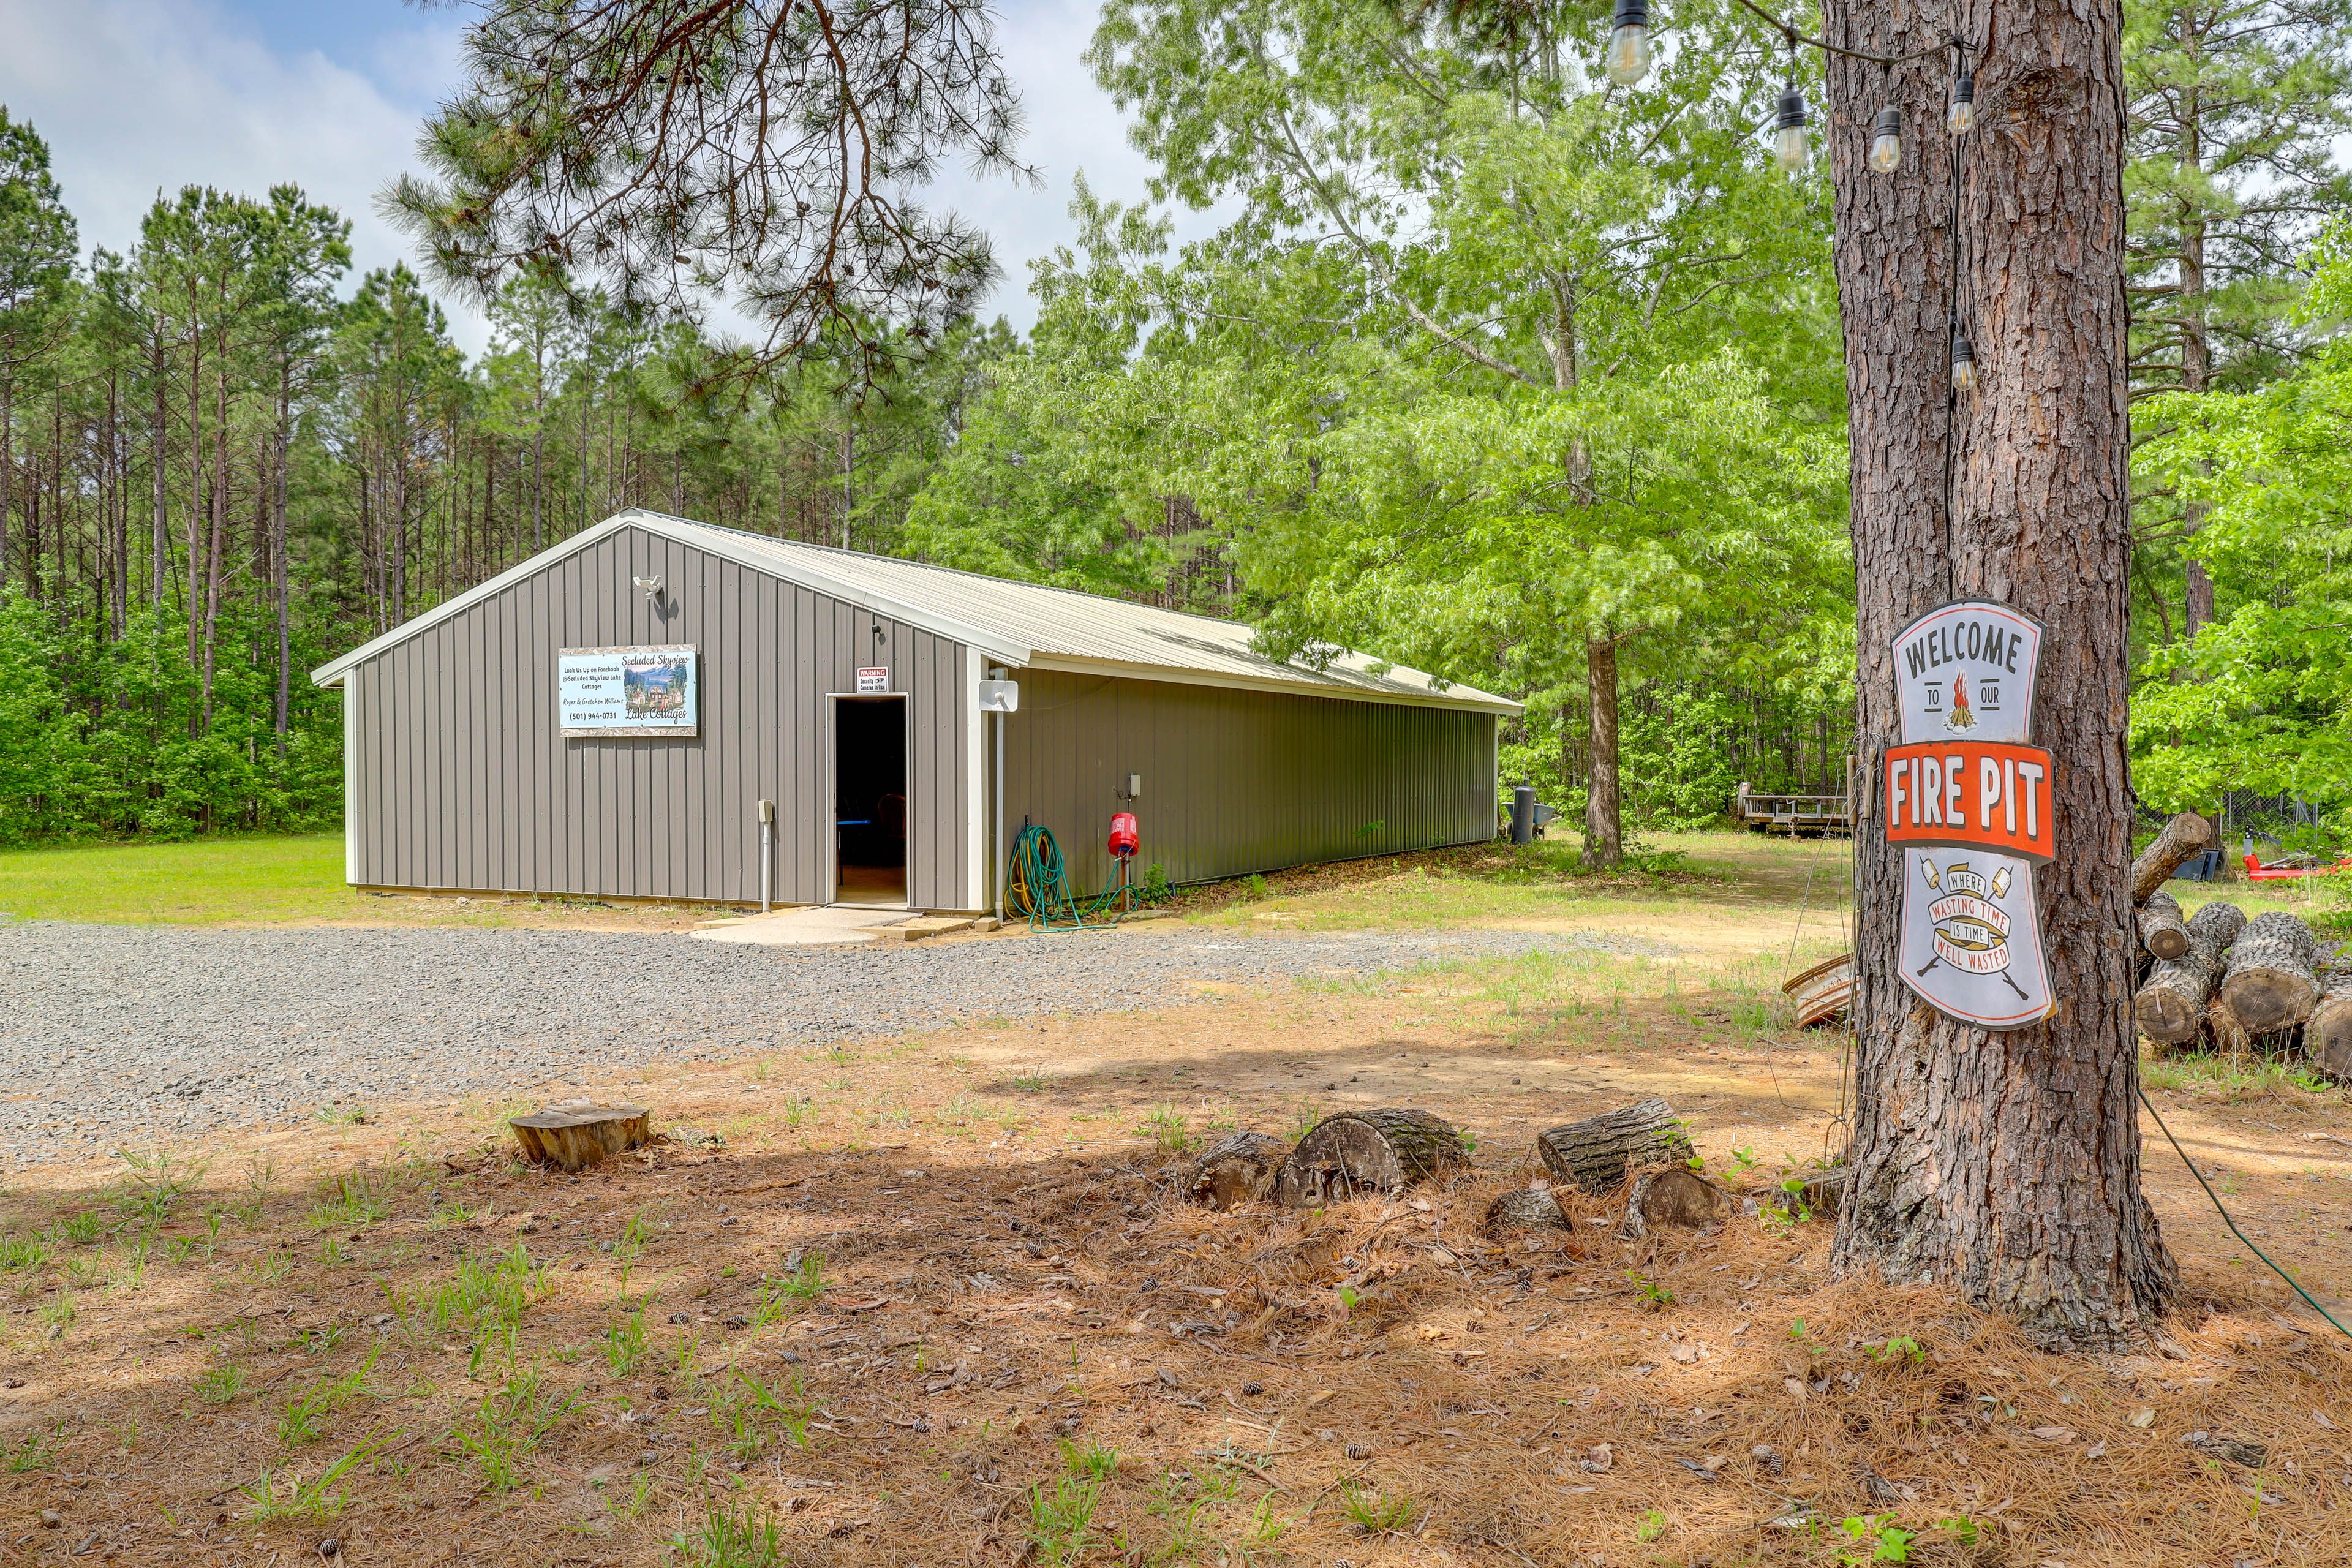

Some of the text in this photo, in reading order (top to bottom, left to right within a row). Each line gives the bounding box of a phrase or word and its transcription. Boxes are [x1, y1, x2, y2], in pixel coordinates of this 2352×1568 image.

[1905, 621, 2022, 679] WELCOME
[622, 654, 689, 668] Secluded Skyview
[1928, 687, 1999, 706] TO OUR
[570, 712, 586, 721] (501)
[625, 707, 687, 724] Lake Cottages
[1891, 755, 2045, 842] FIRE PIT
[1951, 875, 1981, 892] WHERE
[1932, 899, 2007, 931] WASTING TIME
[1953, 924, 1983, 941] IS TIME
[1937, 938, 2007, 970] WELL WASTED
